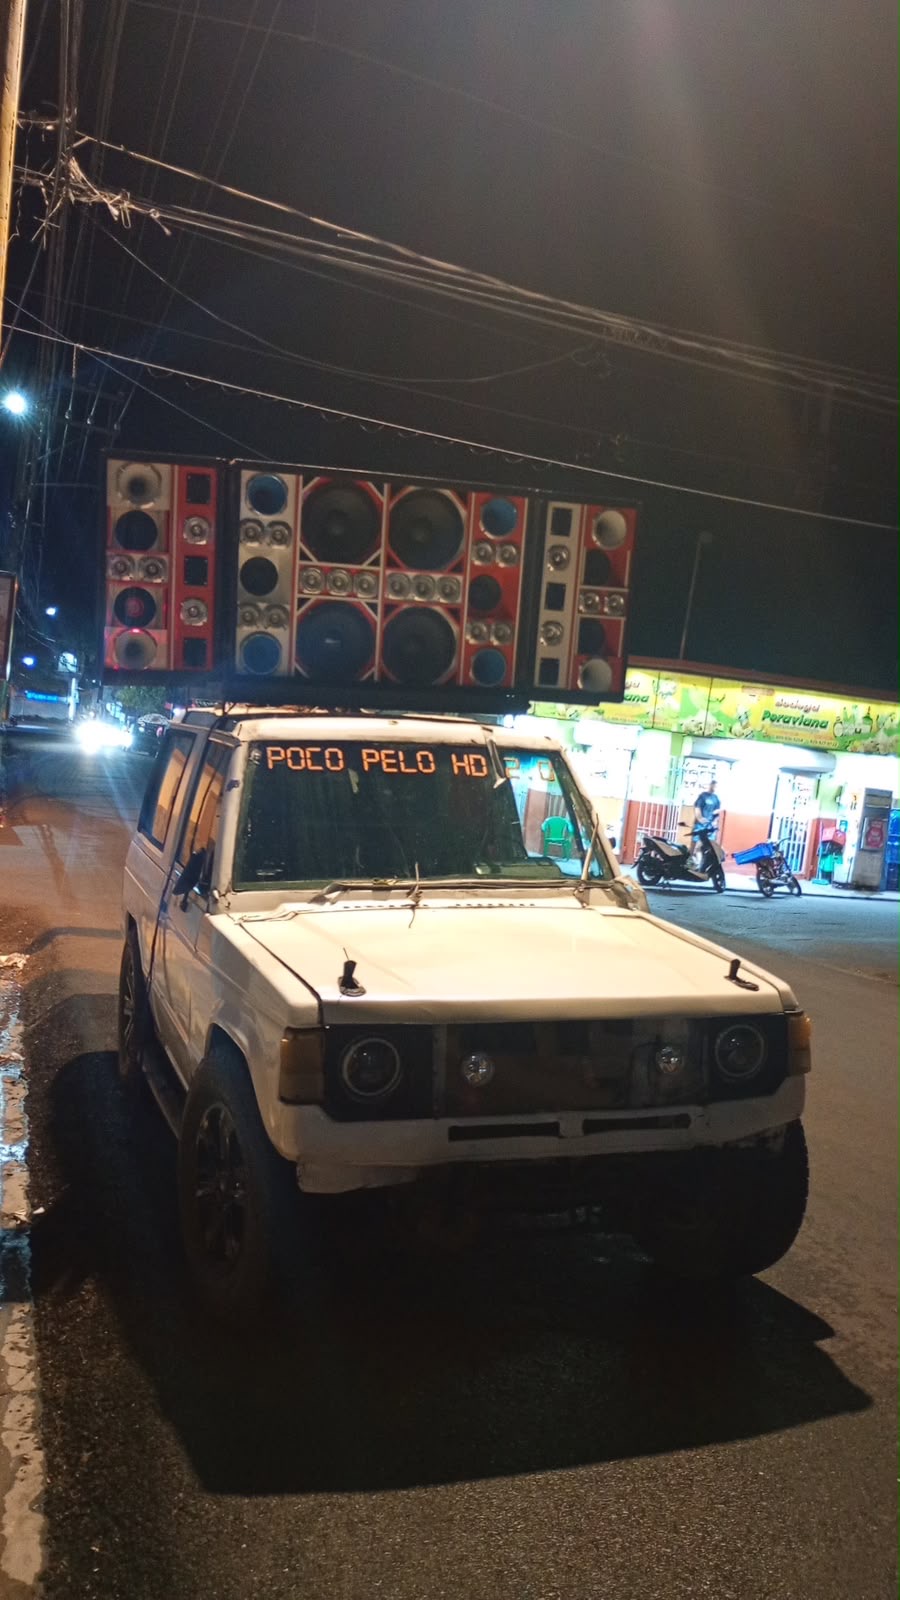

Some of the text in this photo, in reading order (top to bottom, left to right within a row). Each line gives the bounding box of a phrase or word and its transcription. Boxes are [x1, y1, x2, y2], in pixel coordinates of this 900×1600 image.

[266, 746, 344, 772] POCO
[361, 748, 436, 774] PELO
[451, 753, 488, 778] HD
